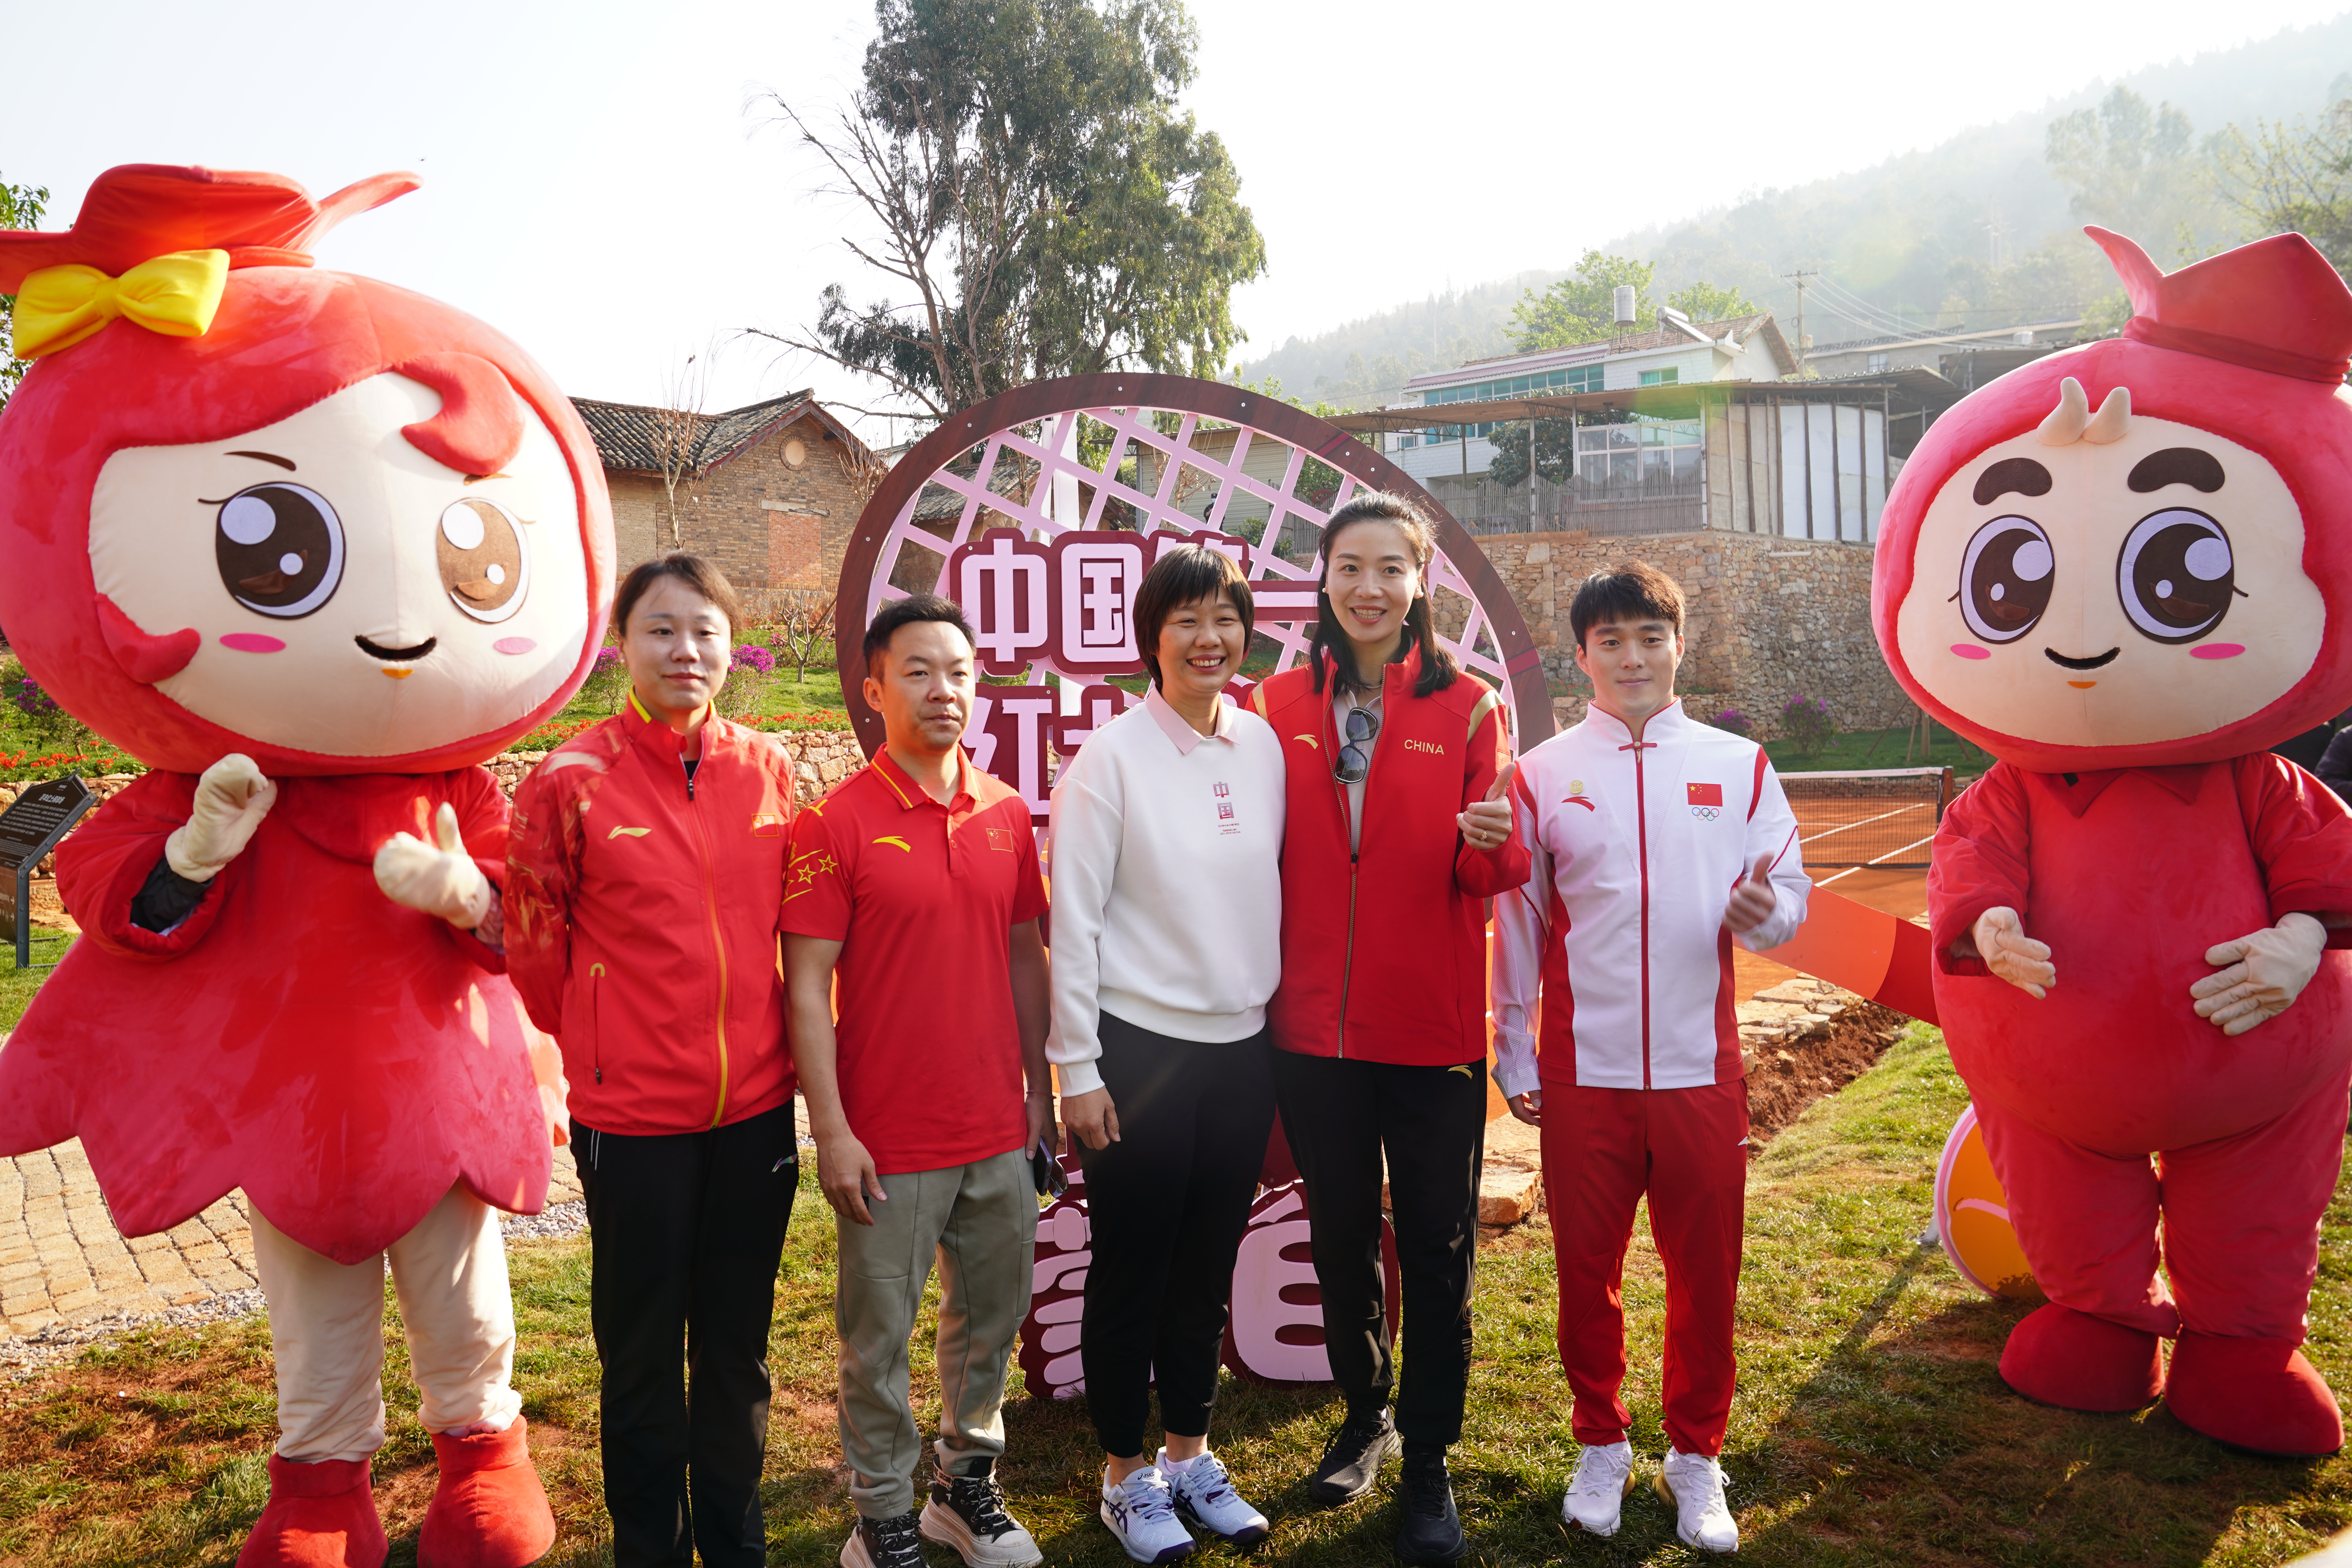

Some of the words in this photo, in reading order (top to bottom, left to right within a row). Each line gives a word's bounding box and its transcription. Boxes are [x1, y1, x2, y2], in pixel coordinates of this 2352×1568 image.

[960, 537, 1318, 662] 中国一
[1404, 739, 1445, 755] CHINA
